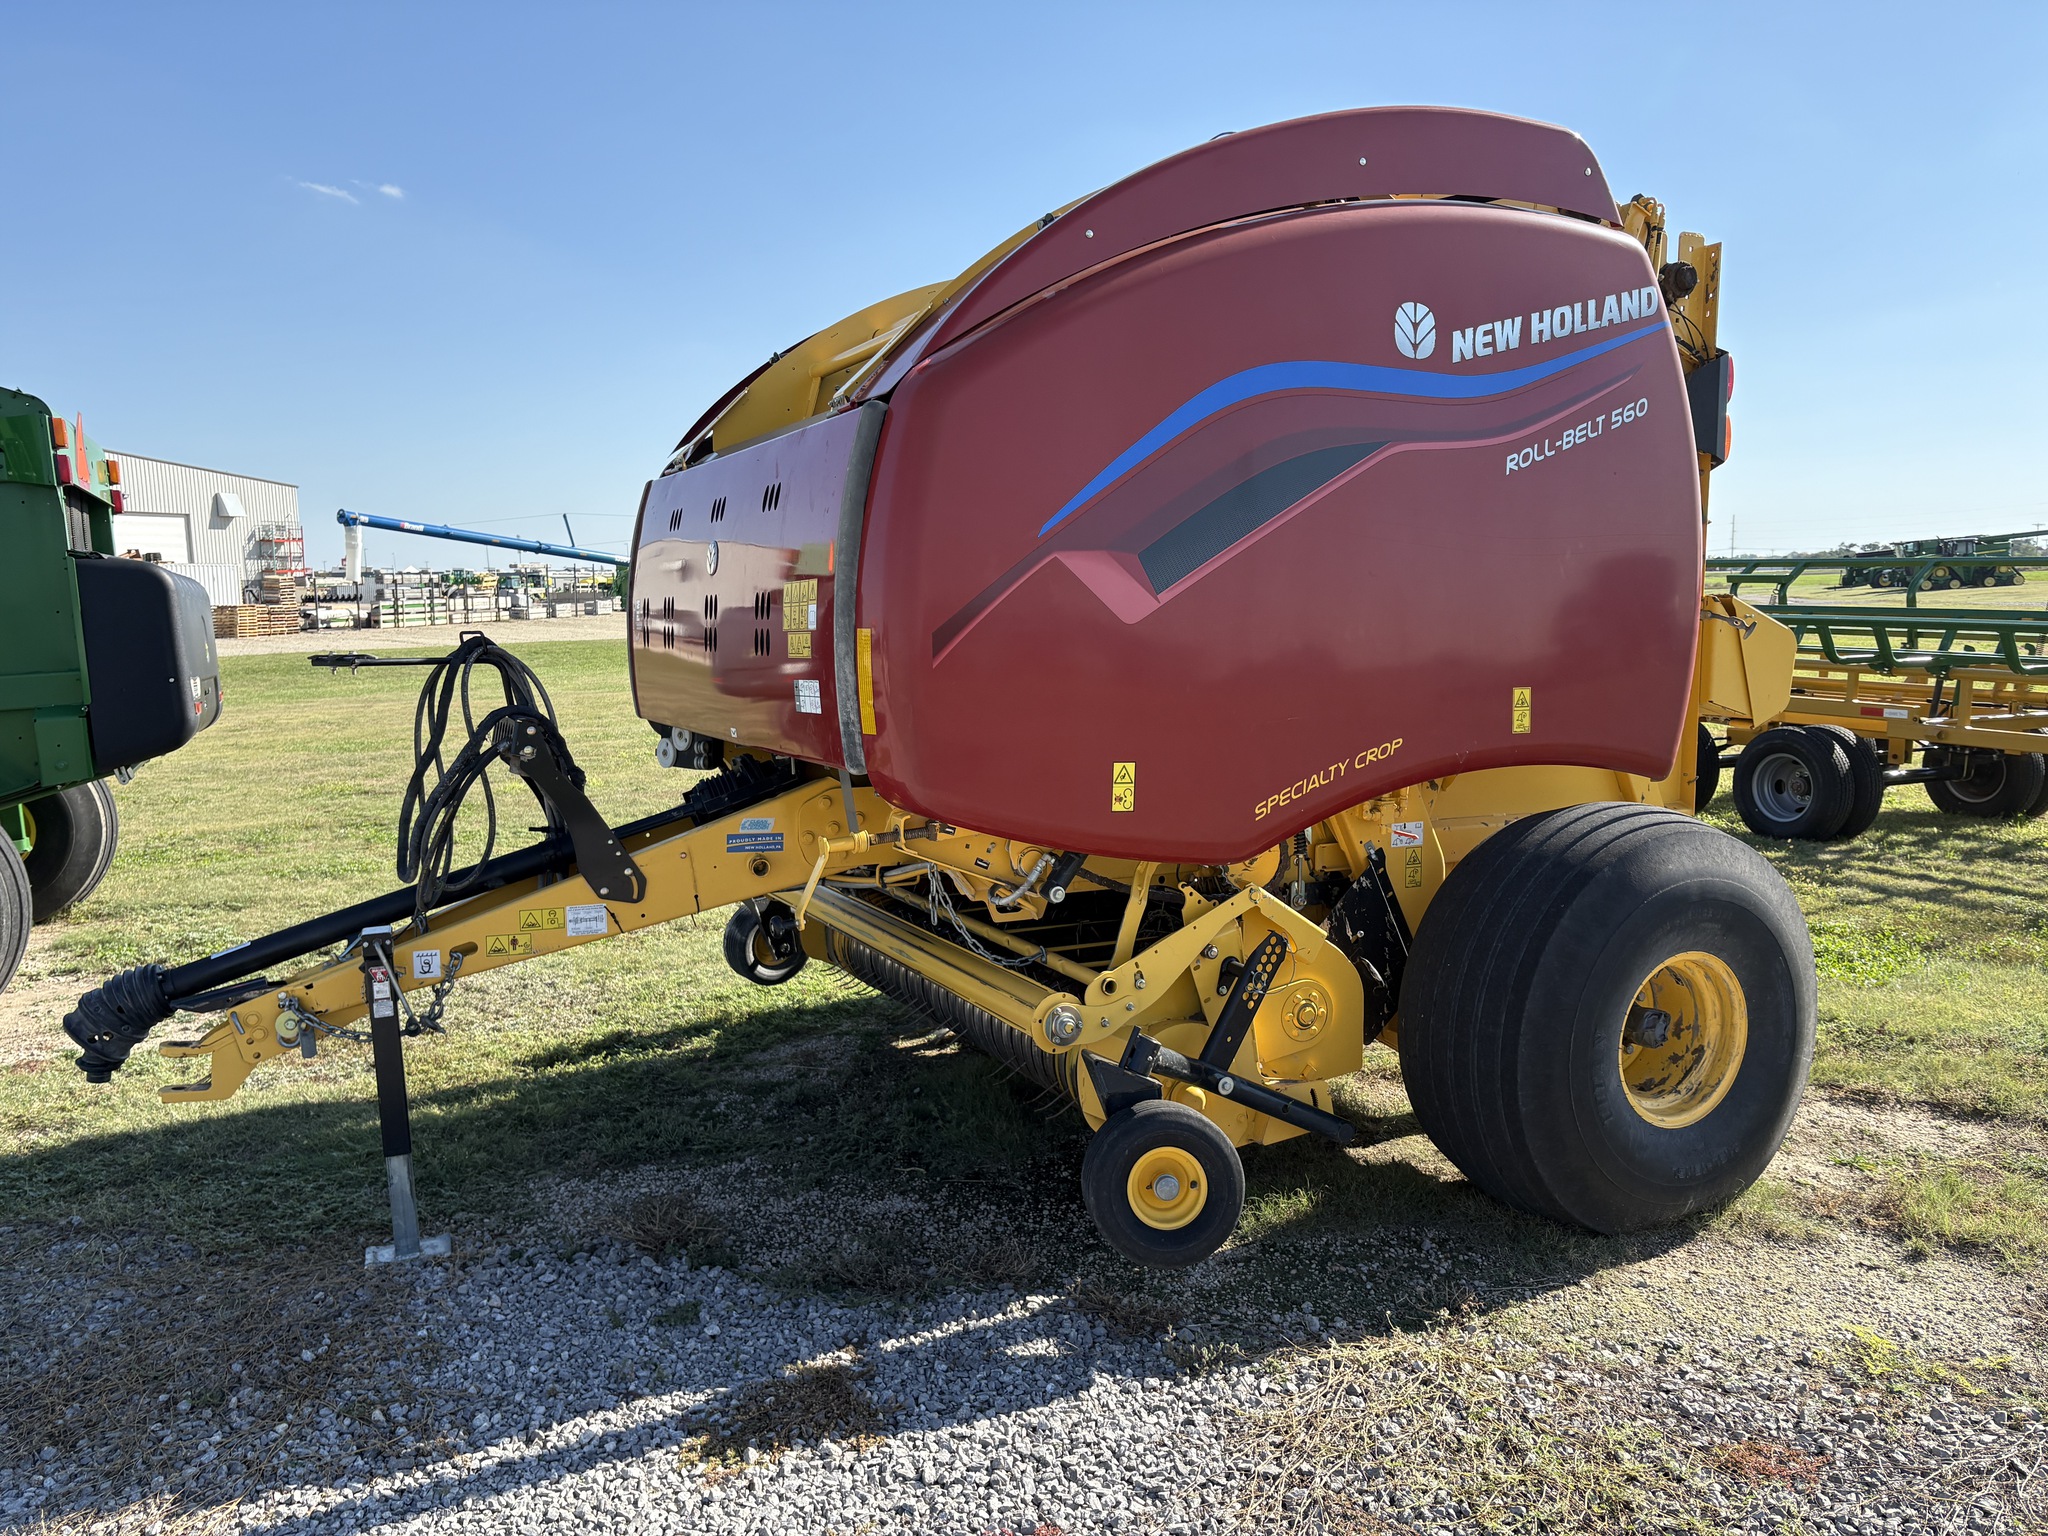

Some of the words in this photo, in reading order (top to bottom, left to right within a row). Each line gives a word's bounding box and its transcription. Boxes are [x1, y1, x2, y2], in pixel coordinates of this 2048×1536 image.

[1452, 316, 1523, 364] NEW
[1531, 285, 1659, 345] HOLLAND
[1505, 414, 1606, 476] ROLL-BELT
[1611, 397, 1649, 430] 560
[1254, 758, 1350, 821] SPECIALTY
[1354, 737, 1403, 769] CROP
